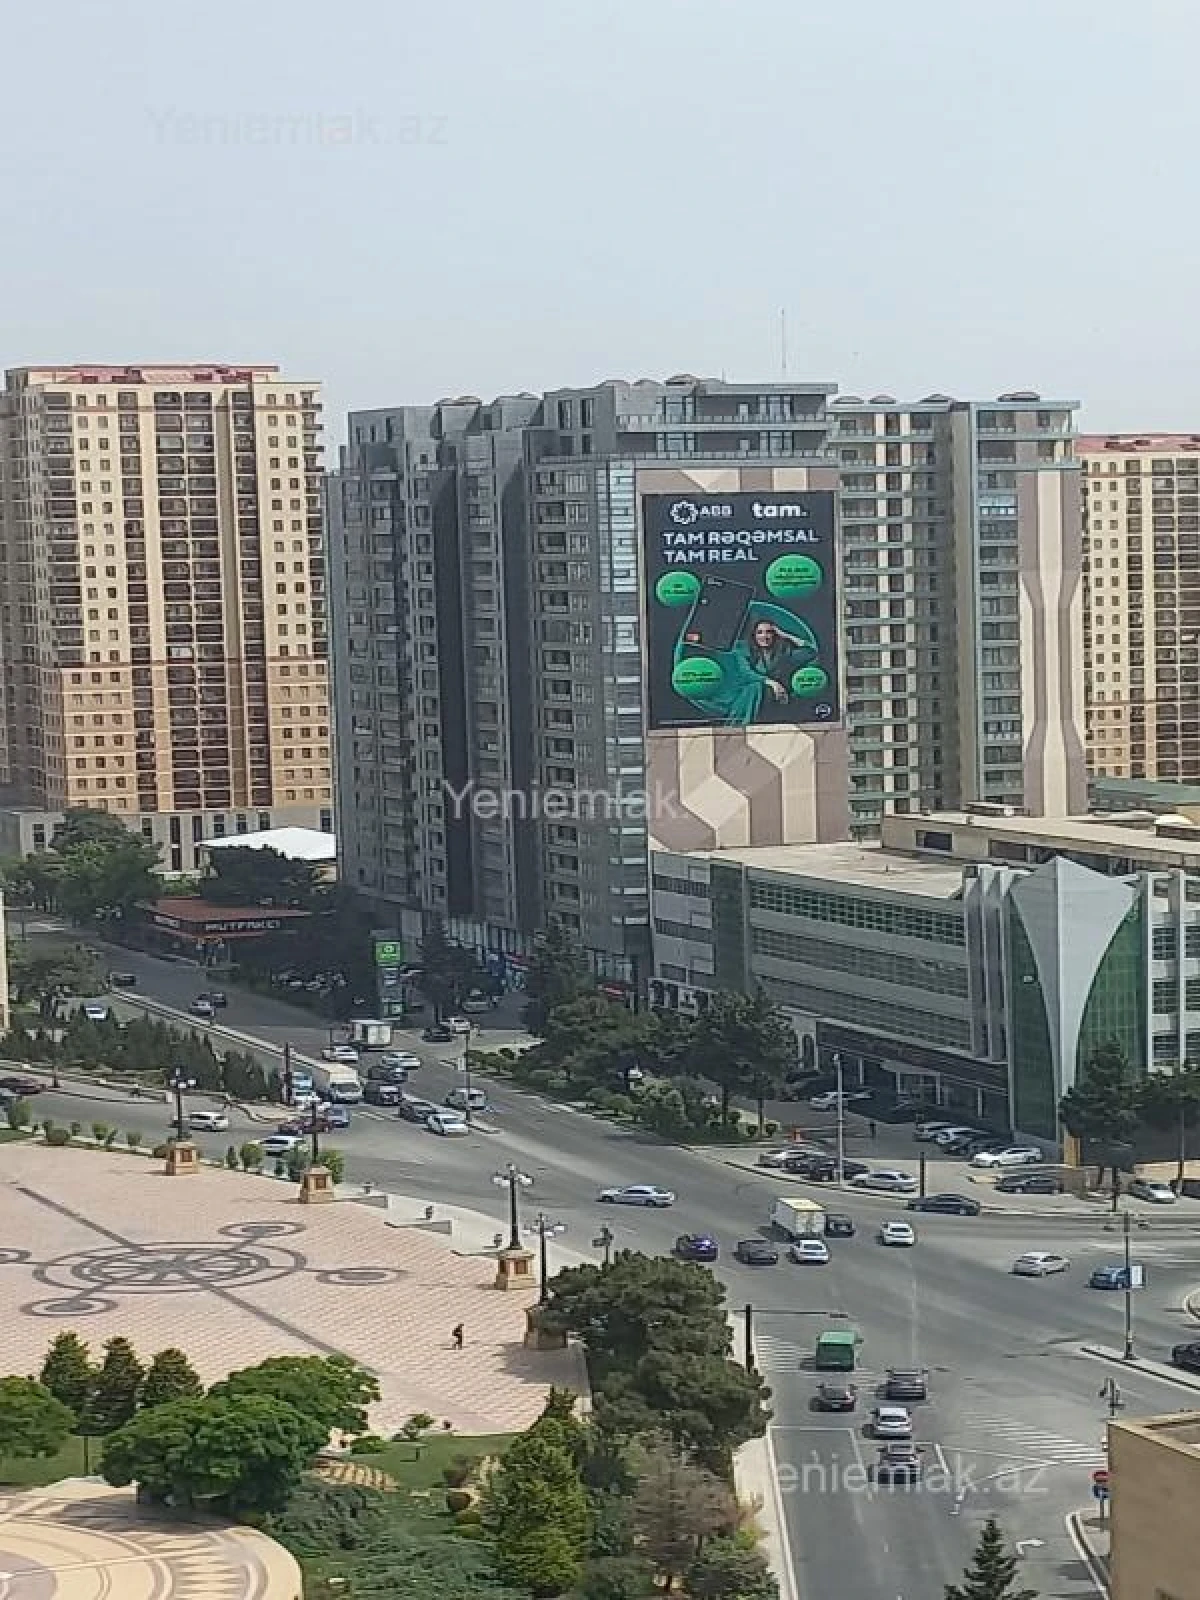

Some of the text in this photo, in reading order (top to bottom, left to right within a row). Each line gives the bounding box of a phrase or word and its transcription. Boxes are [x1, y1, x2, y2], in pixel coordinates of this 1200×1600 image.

[663, 532, 704, 544] TAM
[664, 548, 758, 563] TAM REAL
